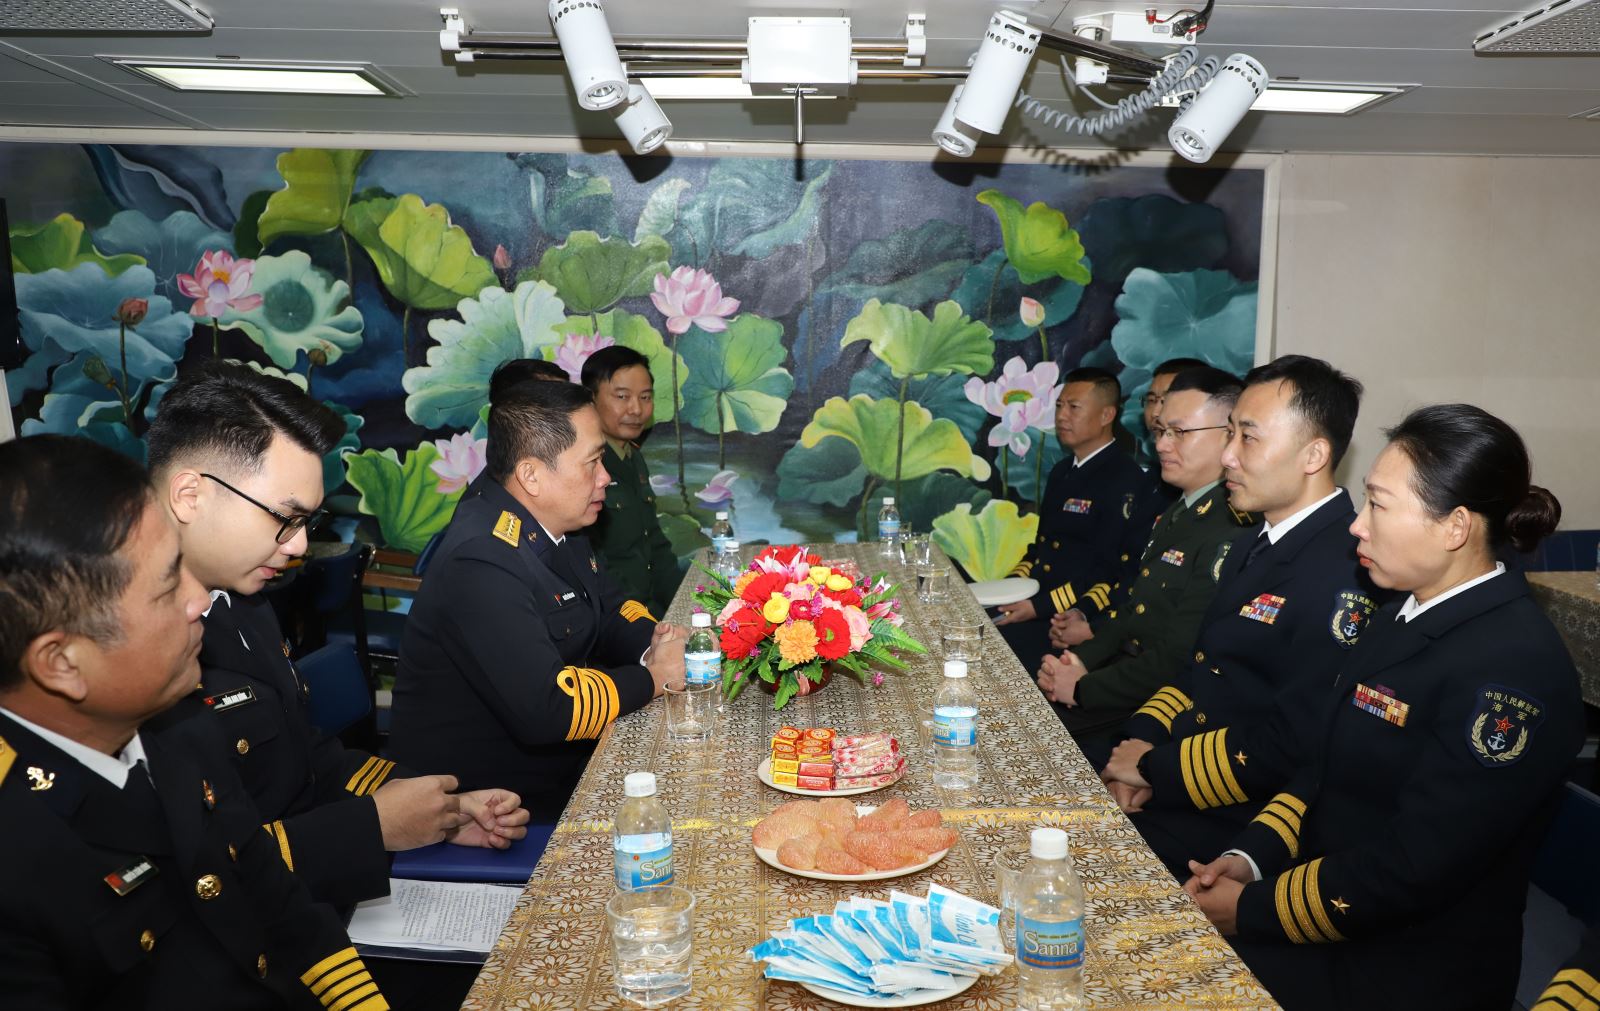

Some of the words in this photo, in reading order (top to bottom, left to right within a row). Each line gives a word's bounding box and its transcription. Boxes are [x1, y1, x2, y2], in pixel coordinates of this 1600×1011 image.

[1485, 690, 1540, 717] 中国人民解放军
[1024, 930, 1078, 956] Sanna
